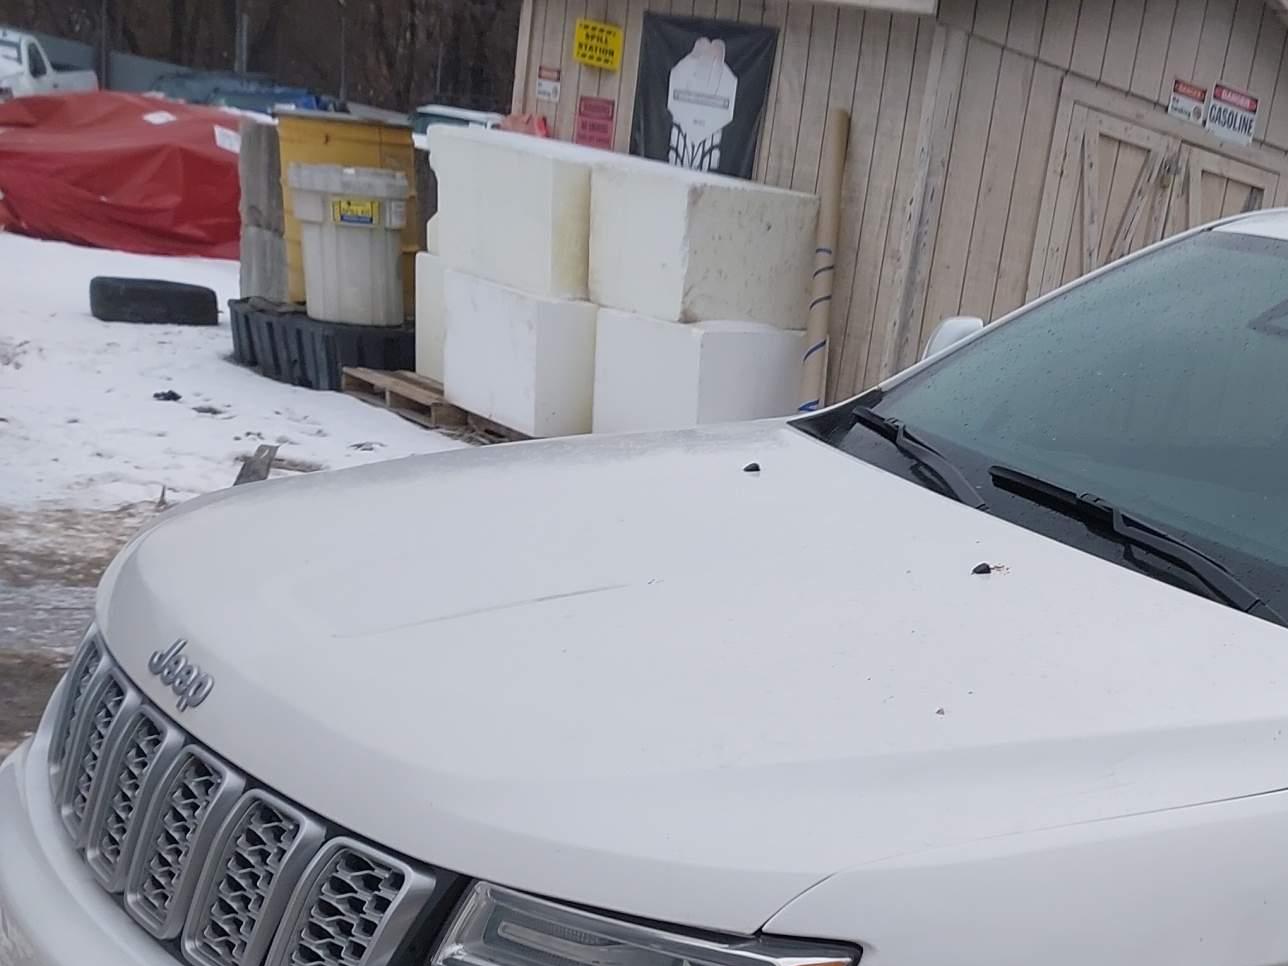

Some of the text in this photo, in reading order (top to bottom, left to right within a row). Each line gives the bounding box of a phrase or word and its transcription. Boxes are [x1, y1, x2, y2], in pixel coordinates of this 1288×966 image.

[578, 42, 615, 57] STATION
[585, 32, 609, 45] SPILL
[1209, 104, 1254, 136] GASOLINE
[148, 639, 214, 712] Jeep
